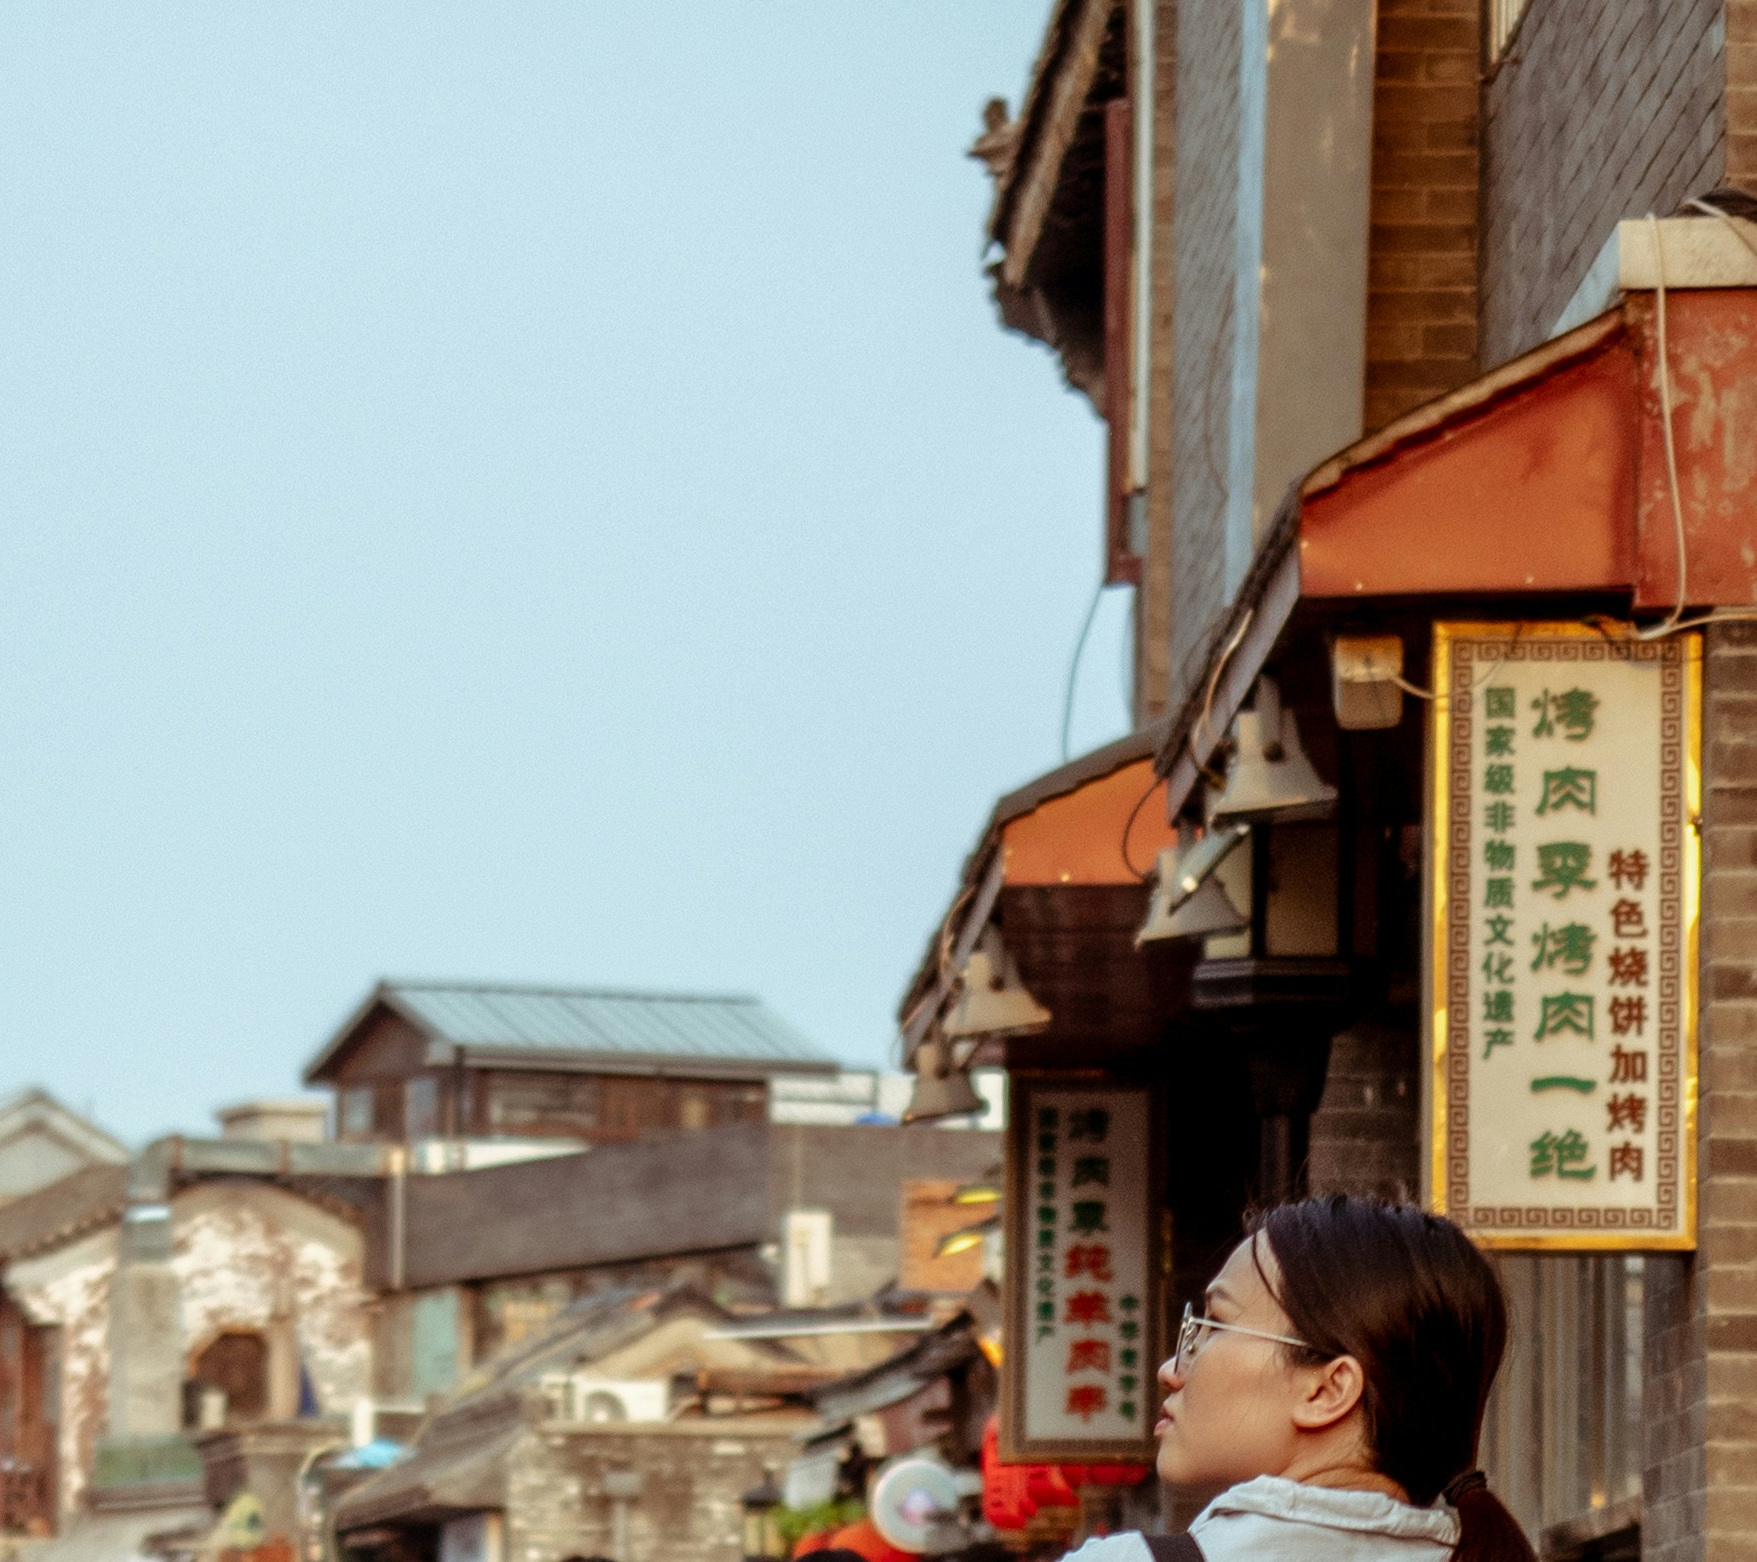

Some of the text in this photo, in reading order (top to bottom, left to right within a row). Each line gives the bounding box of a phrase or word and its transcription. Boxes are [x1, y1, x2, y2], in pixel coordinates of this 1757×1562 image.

[1483, 687, 1516, 1060] 国家级非物质文化遗产
[1607, 849, 1649, 1181] 特色烧饼加烤肉
